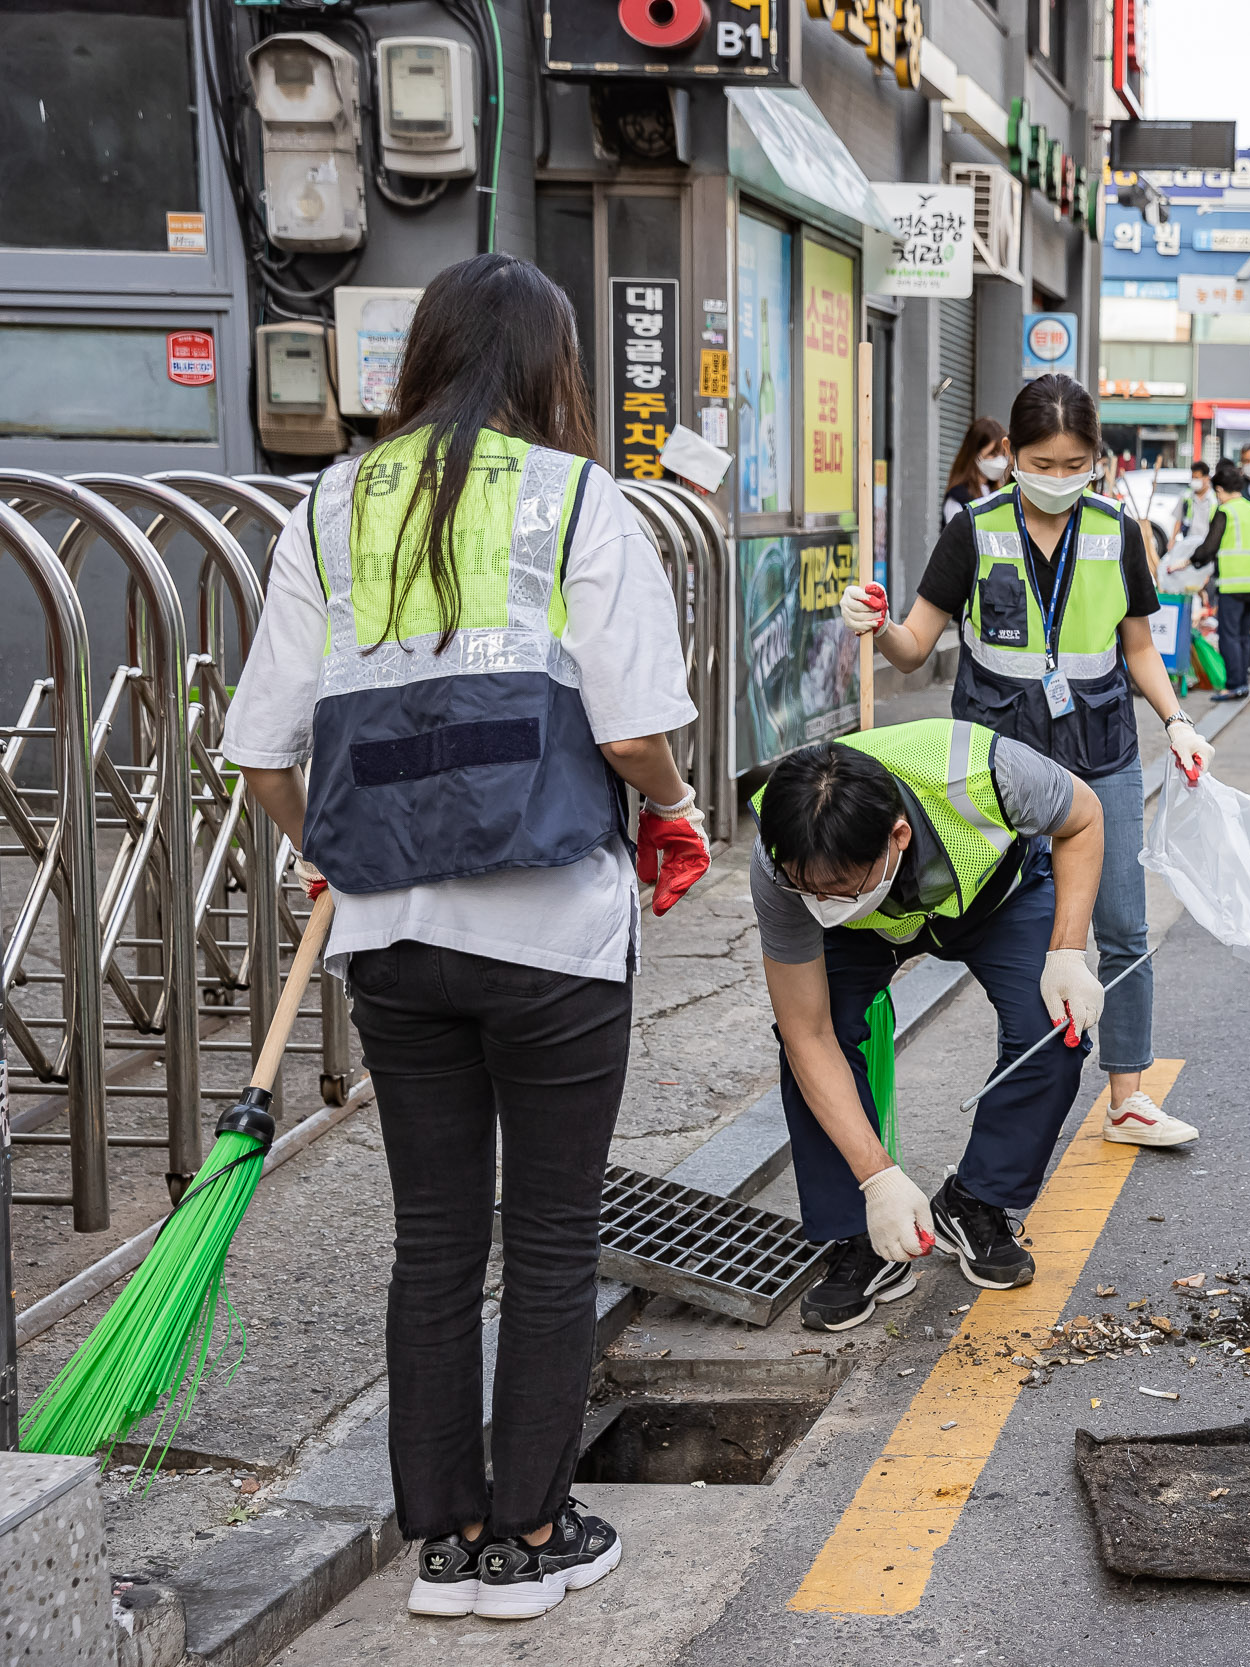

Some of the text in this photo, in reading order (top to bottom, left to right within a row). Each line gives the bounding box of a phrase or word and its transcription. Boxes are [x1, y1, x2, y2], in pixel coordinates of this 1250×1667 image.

[717, 21, 762, 59] B1
[805, 284, 851, 359] 소곱창
[1034, 330, 1065, 347] 담배
[817, 379, 840, 425] 포장
